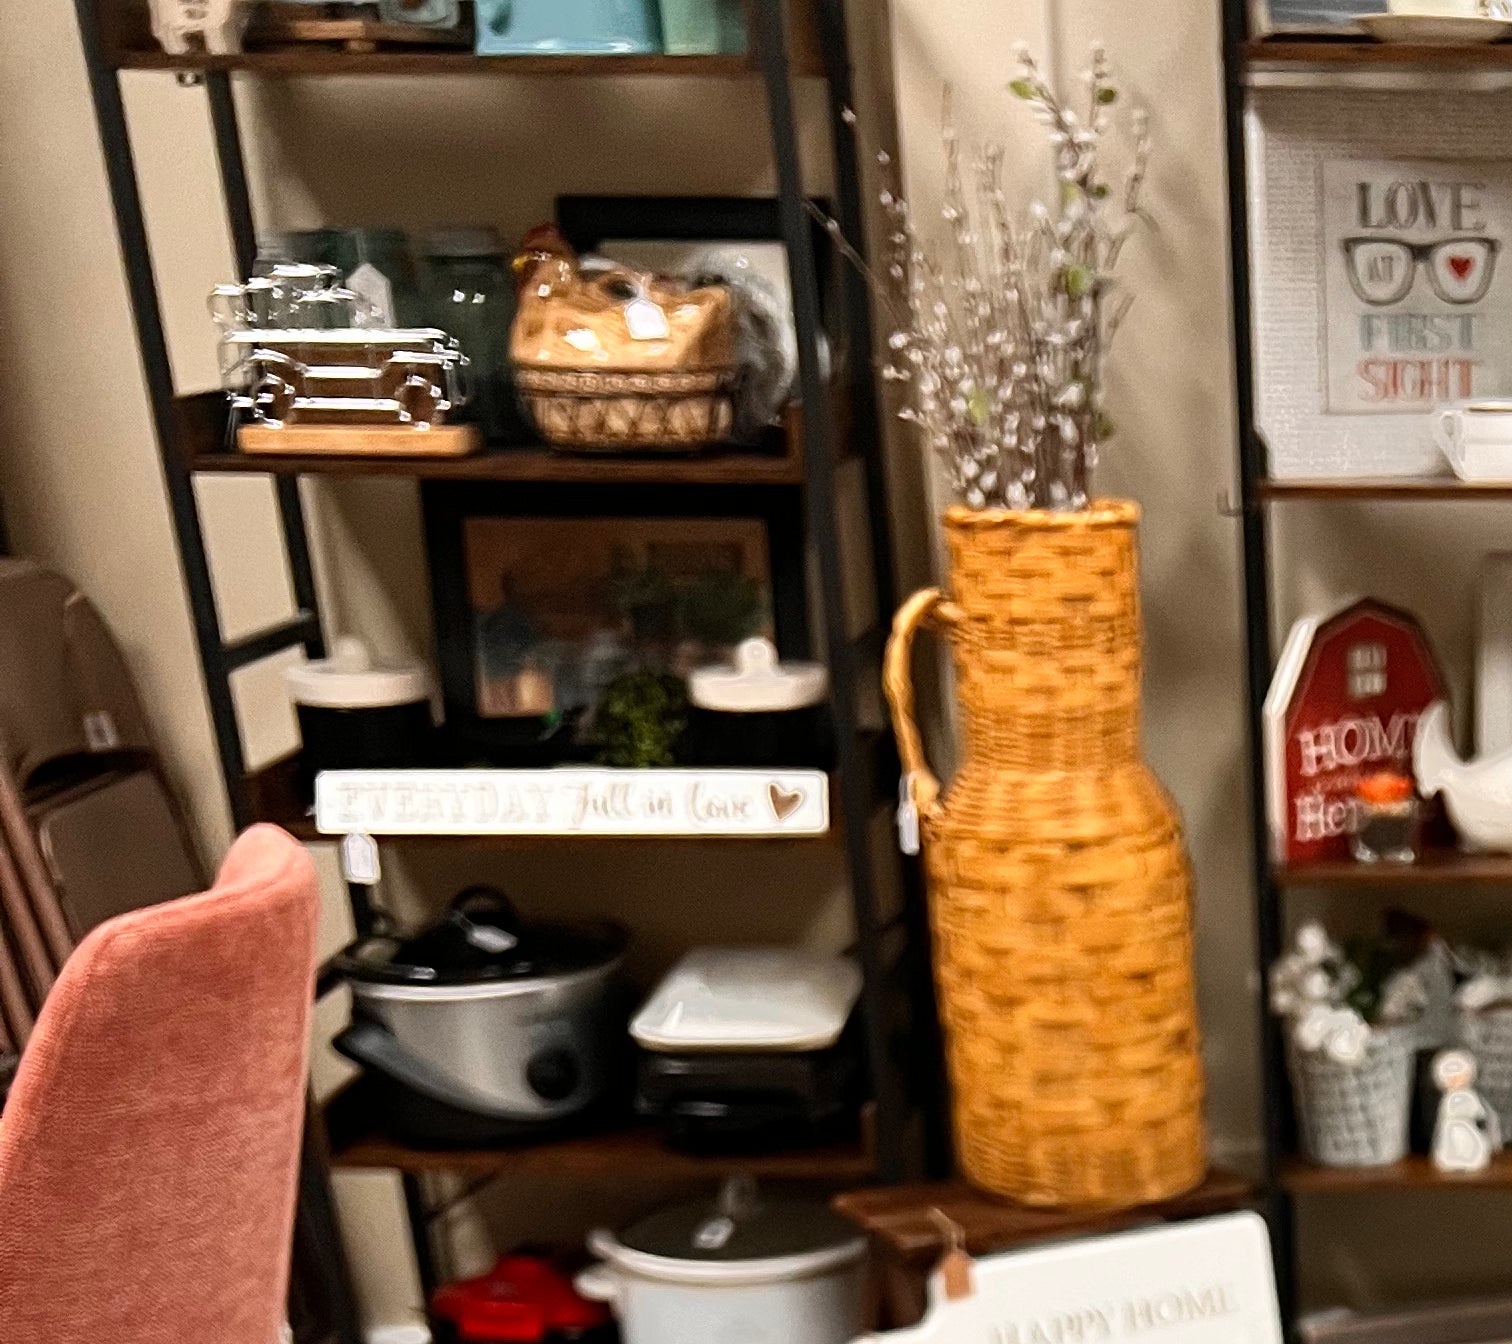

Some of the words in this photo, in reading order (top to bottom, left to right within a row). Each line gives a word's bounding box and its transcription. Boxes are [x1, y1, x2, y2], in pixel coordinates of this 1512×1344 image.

[1356, 180, 1487, 232] LOVE
[1358, 313, 1480, 351] FIRST
[1357, 358, 1478, 401] SIGHT
[1120, 1284, 1236, 1332] HOME
